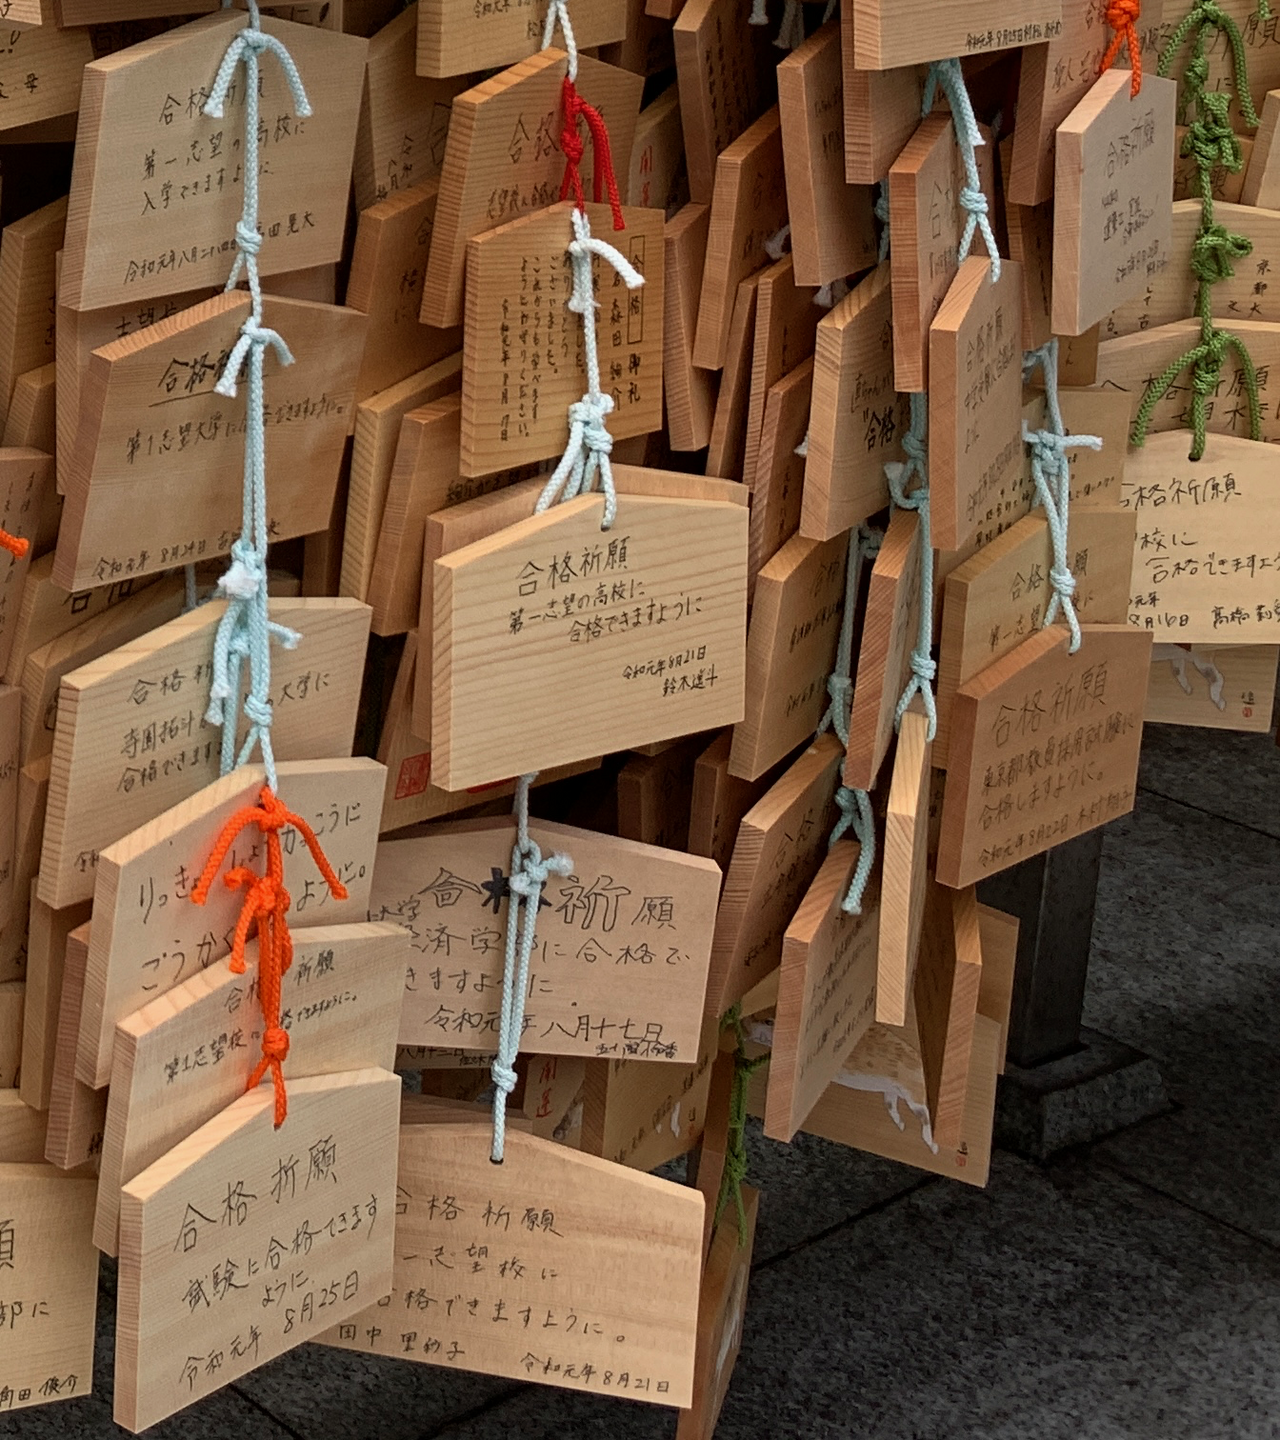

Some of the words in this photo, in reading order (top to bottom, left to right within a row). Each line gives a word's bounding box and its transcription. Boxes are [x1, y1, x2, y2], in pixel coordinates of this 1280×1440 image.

[515, 534, 632, 598] 合格祈願
[508, 578, 647, 636] 第一志望の高校に
[568, 592, 705, 644] 合格できますように
[180, 1194, 379, 1311] 試験に合格できます
